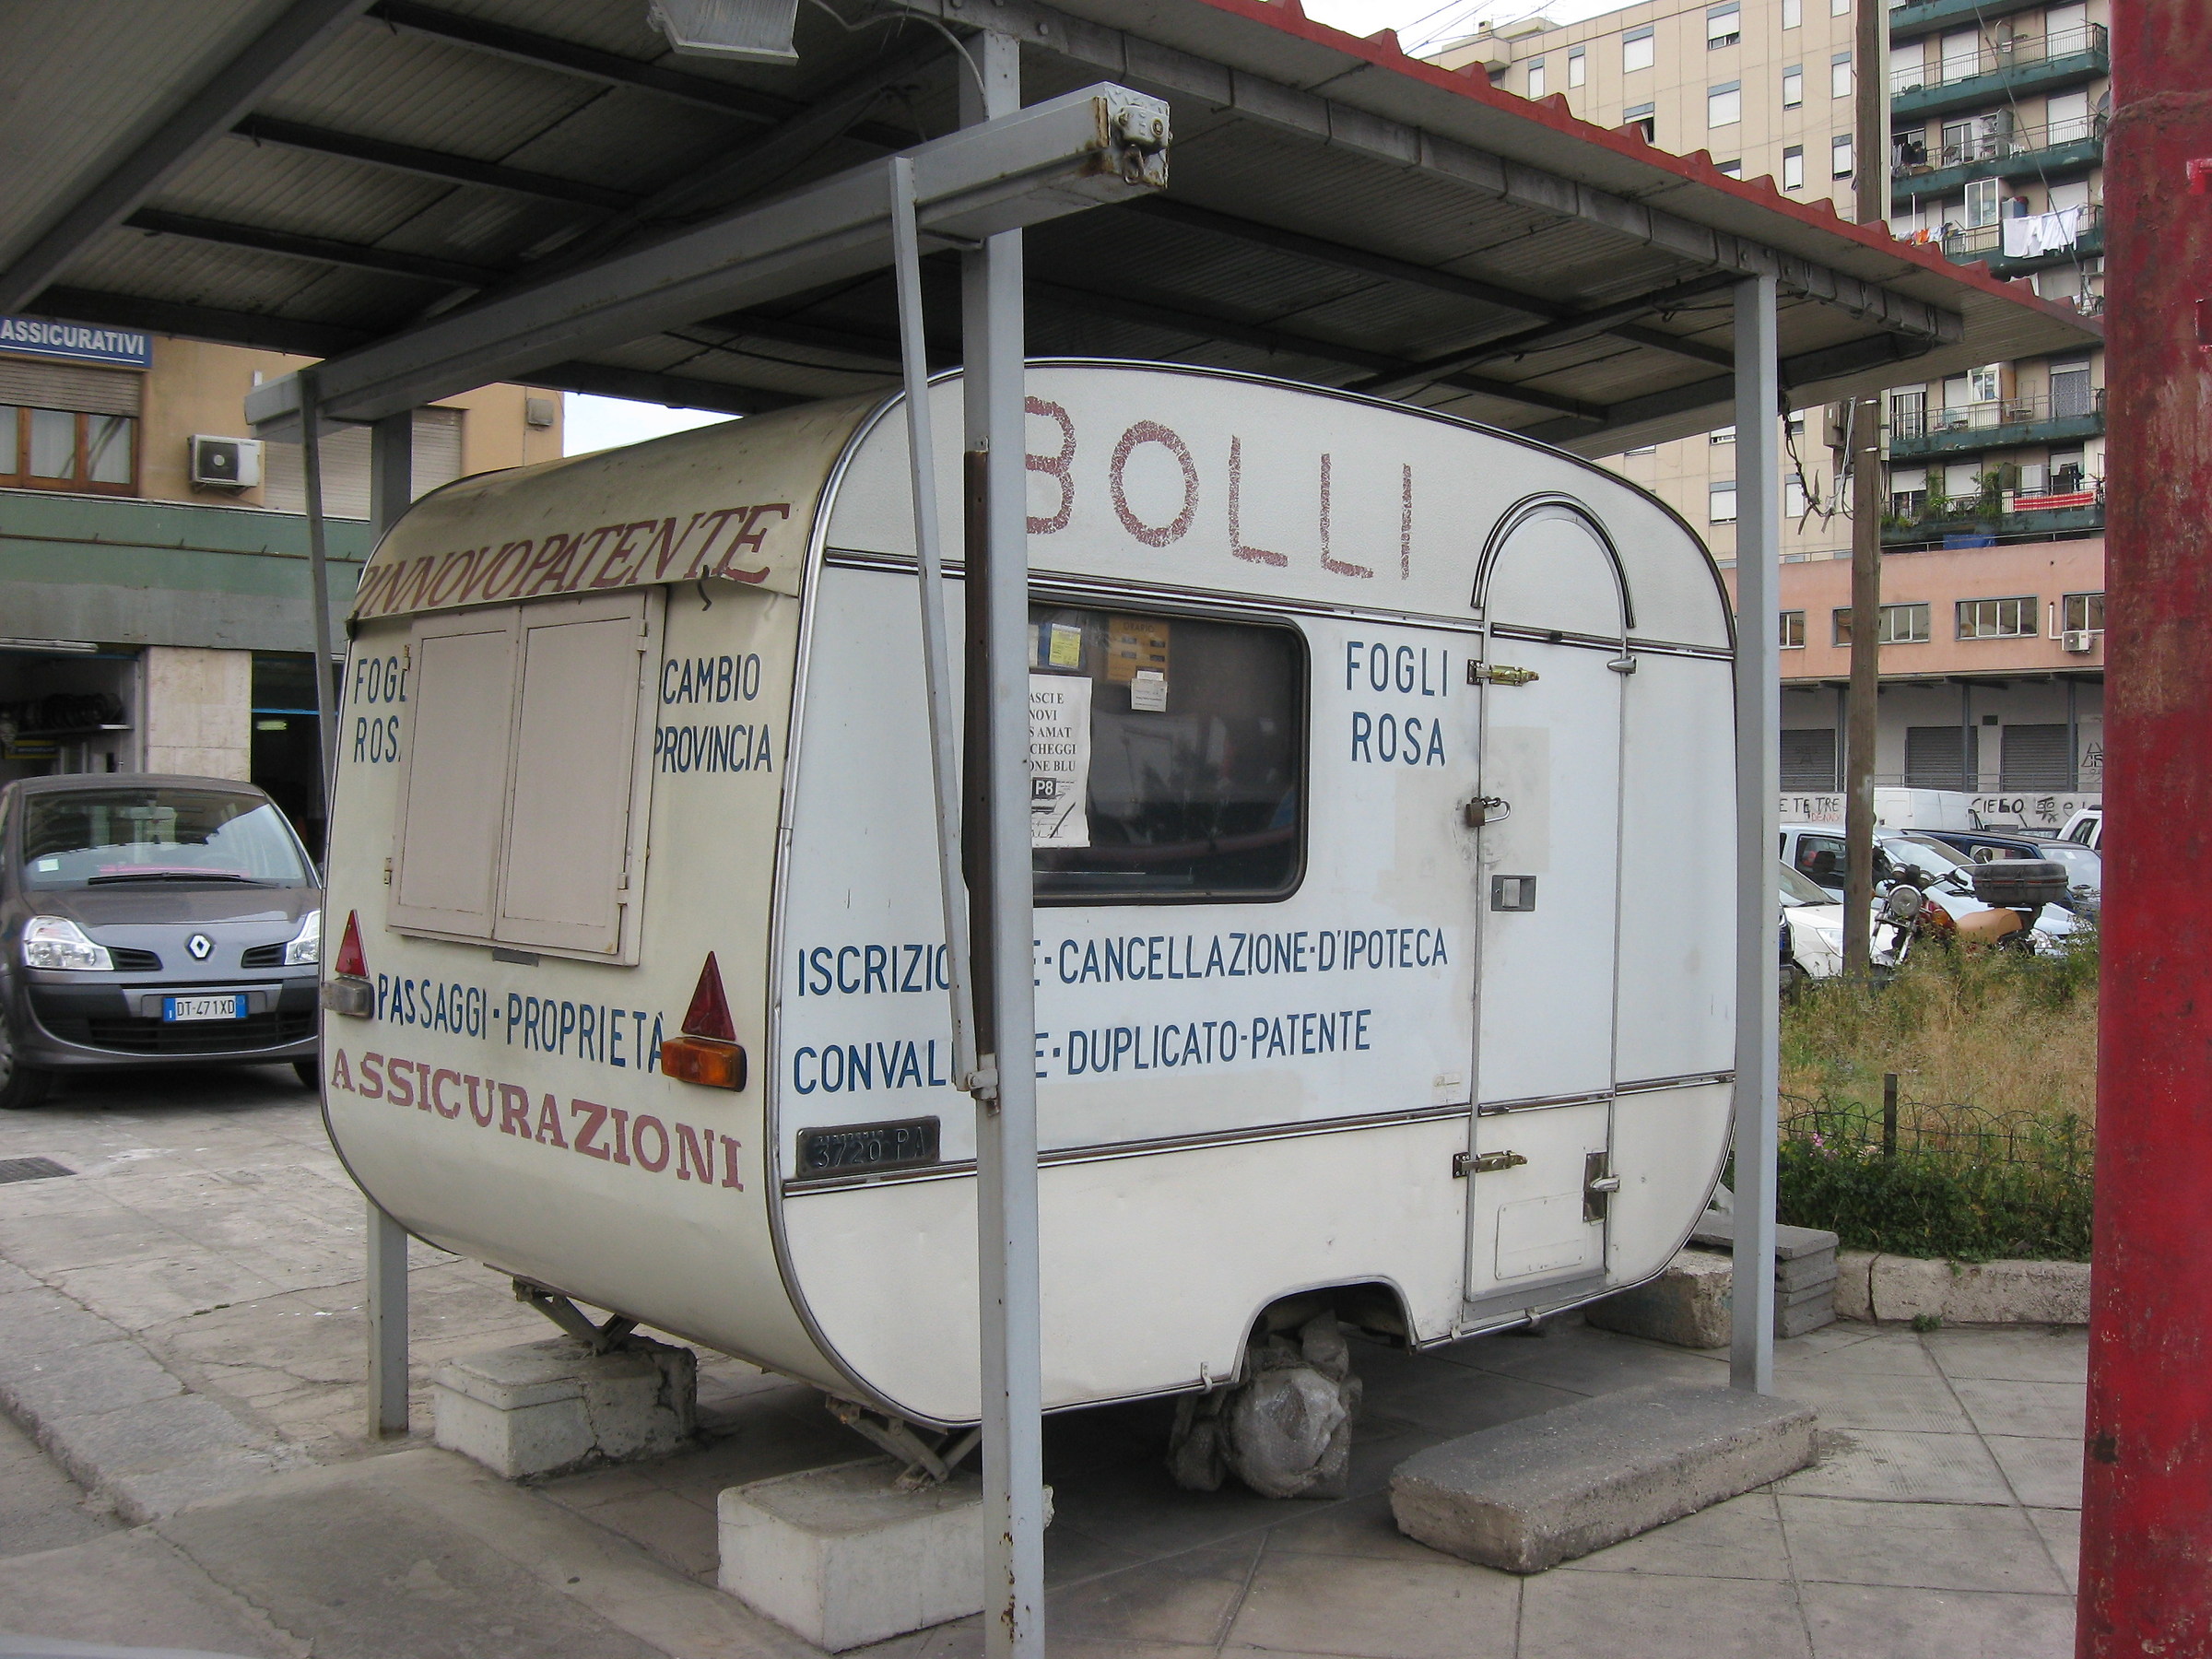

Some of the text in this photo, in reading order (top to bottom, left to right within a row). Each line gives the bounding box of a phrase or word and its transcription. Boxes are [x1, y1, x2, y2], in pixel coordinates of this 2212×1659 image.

[0, 319, 145, 356] ASSICURATIVI
[1025, 395, 1412, 581] BOLLI
[354, 655, 406, 705] FOGL
[663, 653, 761, 705] CAMBIO
[1346, 641, 1448, 698] FOGLI
[1030, 692, 1053, 704] ASCI
[1030, 710, 1057, 721] NOVI
[354, 714, 402, 764] ROS
[1030, 743, 1077, 755] CHEGGI
[1038, 726, 1072, 738] AMAT
[1351, 711, 1446, 767] ROSA
[1053, 760, 1077, 771] BLU
[1035, 780, 1053, 795] P8
[798, 944, 950, 997] ISCRIZIO
[331, 1048, 745, 1193] ASSICURAZIONI
[816, 1138, 882, 1169] 3720
